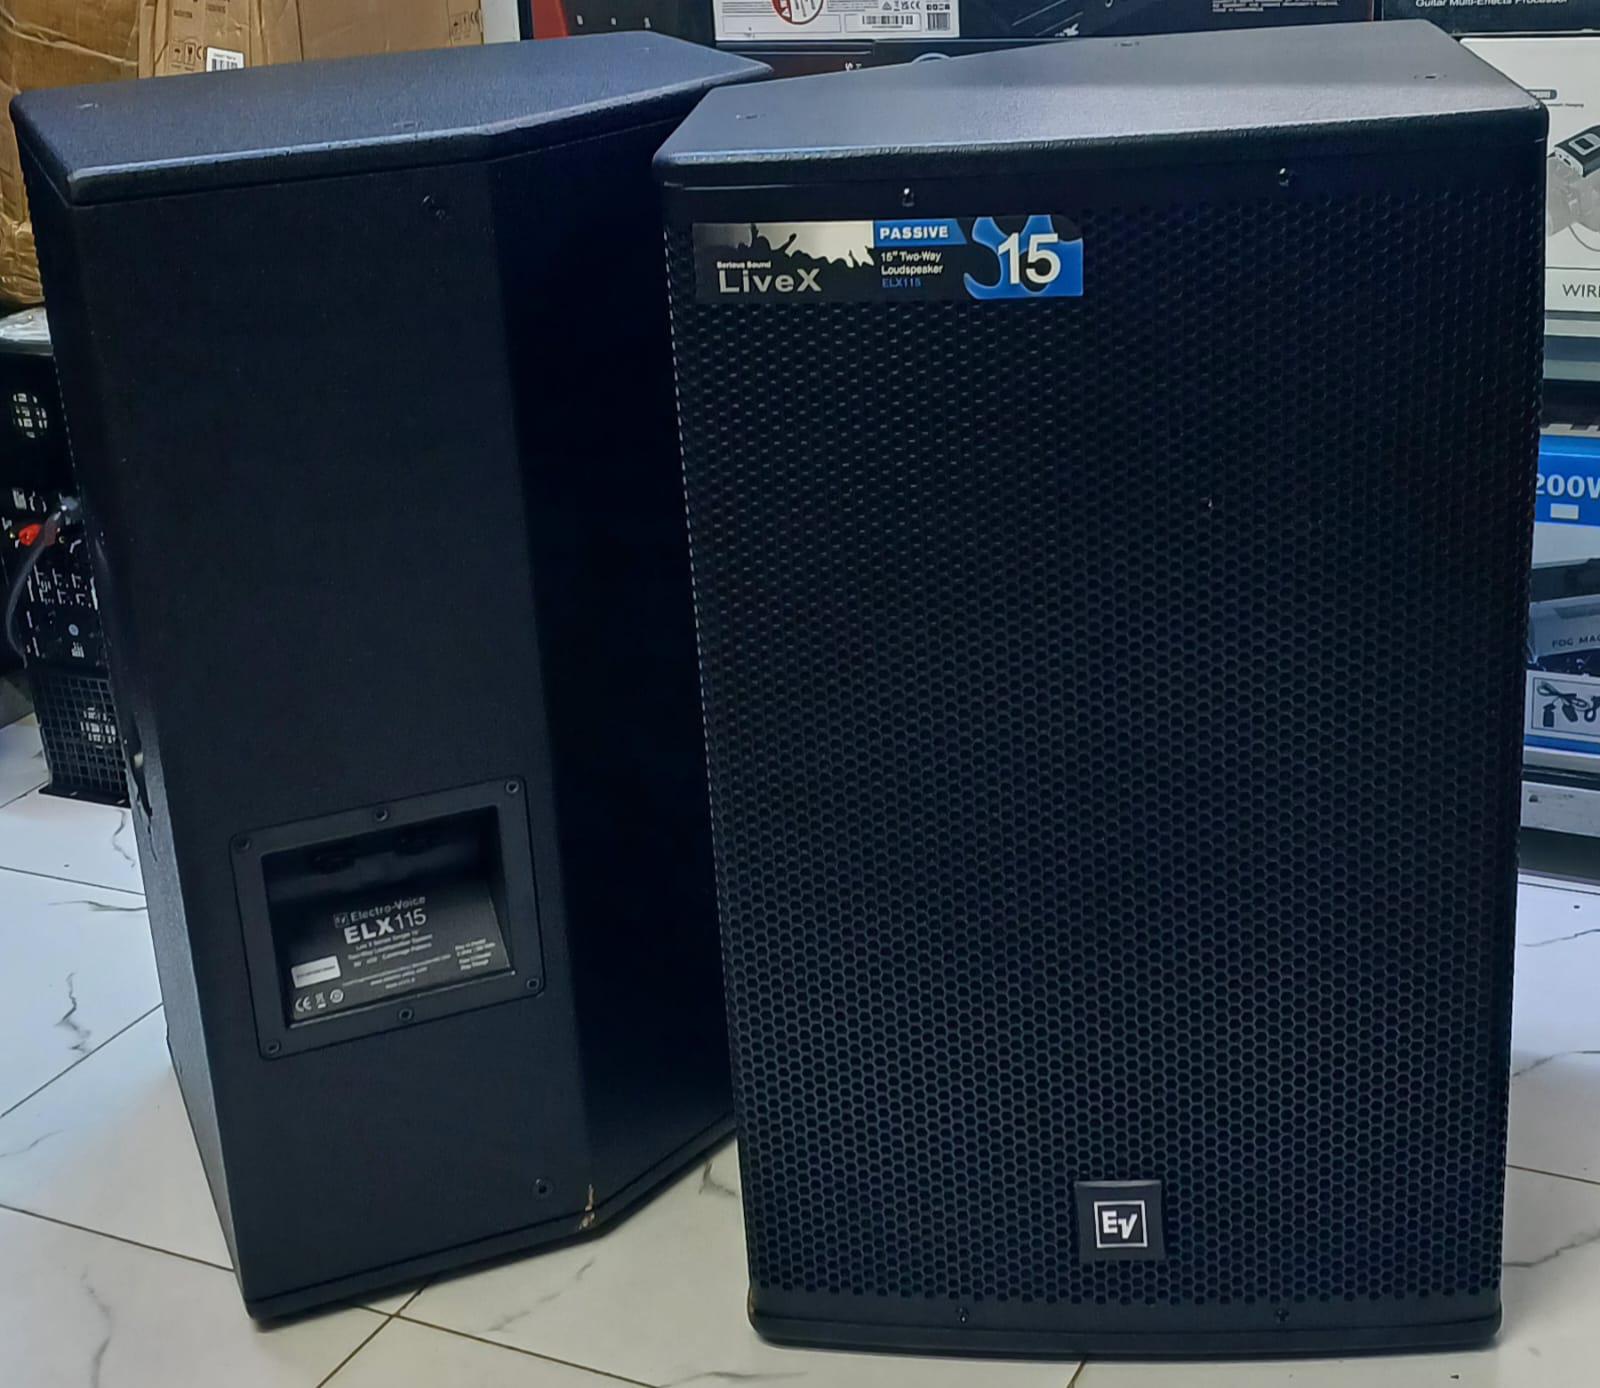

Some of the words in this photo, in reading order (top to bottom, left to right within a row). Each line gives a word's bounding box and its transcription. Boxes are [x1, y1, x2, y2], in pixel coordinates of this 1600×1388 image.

[879, 225, 949, 240] PASSIVE
[899, 250, 942, 263] Two-Way
[998, 232, 1061, 284] 15
[881, 264, 944, 277] Loudspeaker
[718, 268, 822, 293] LiveX
[1562, 283, 1600, 298] WIR
[1552, 638, 1574, 649] FOG
[350, 896, 426, 924] Electro-Voice
[344, 908, 427, 945] ELX115
